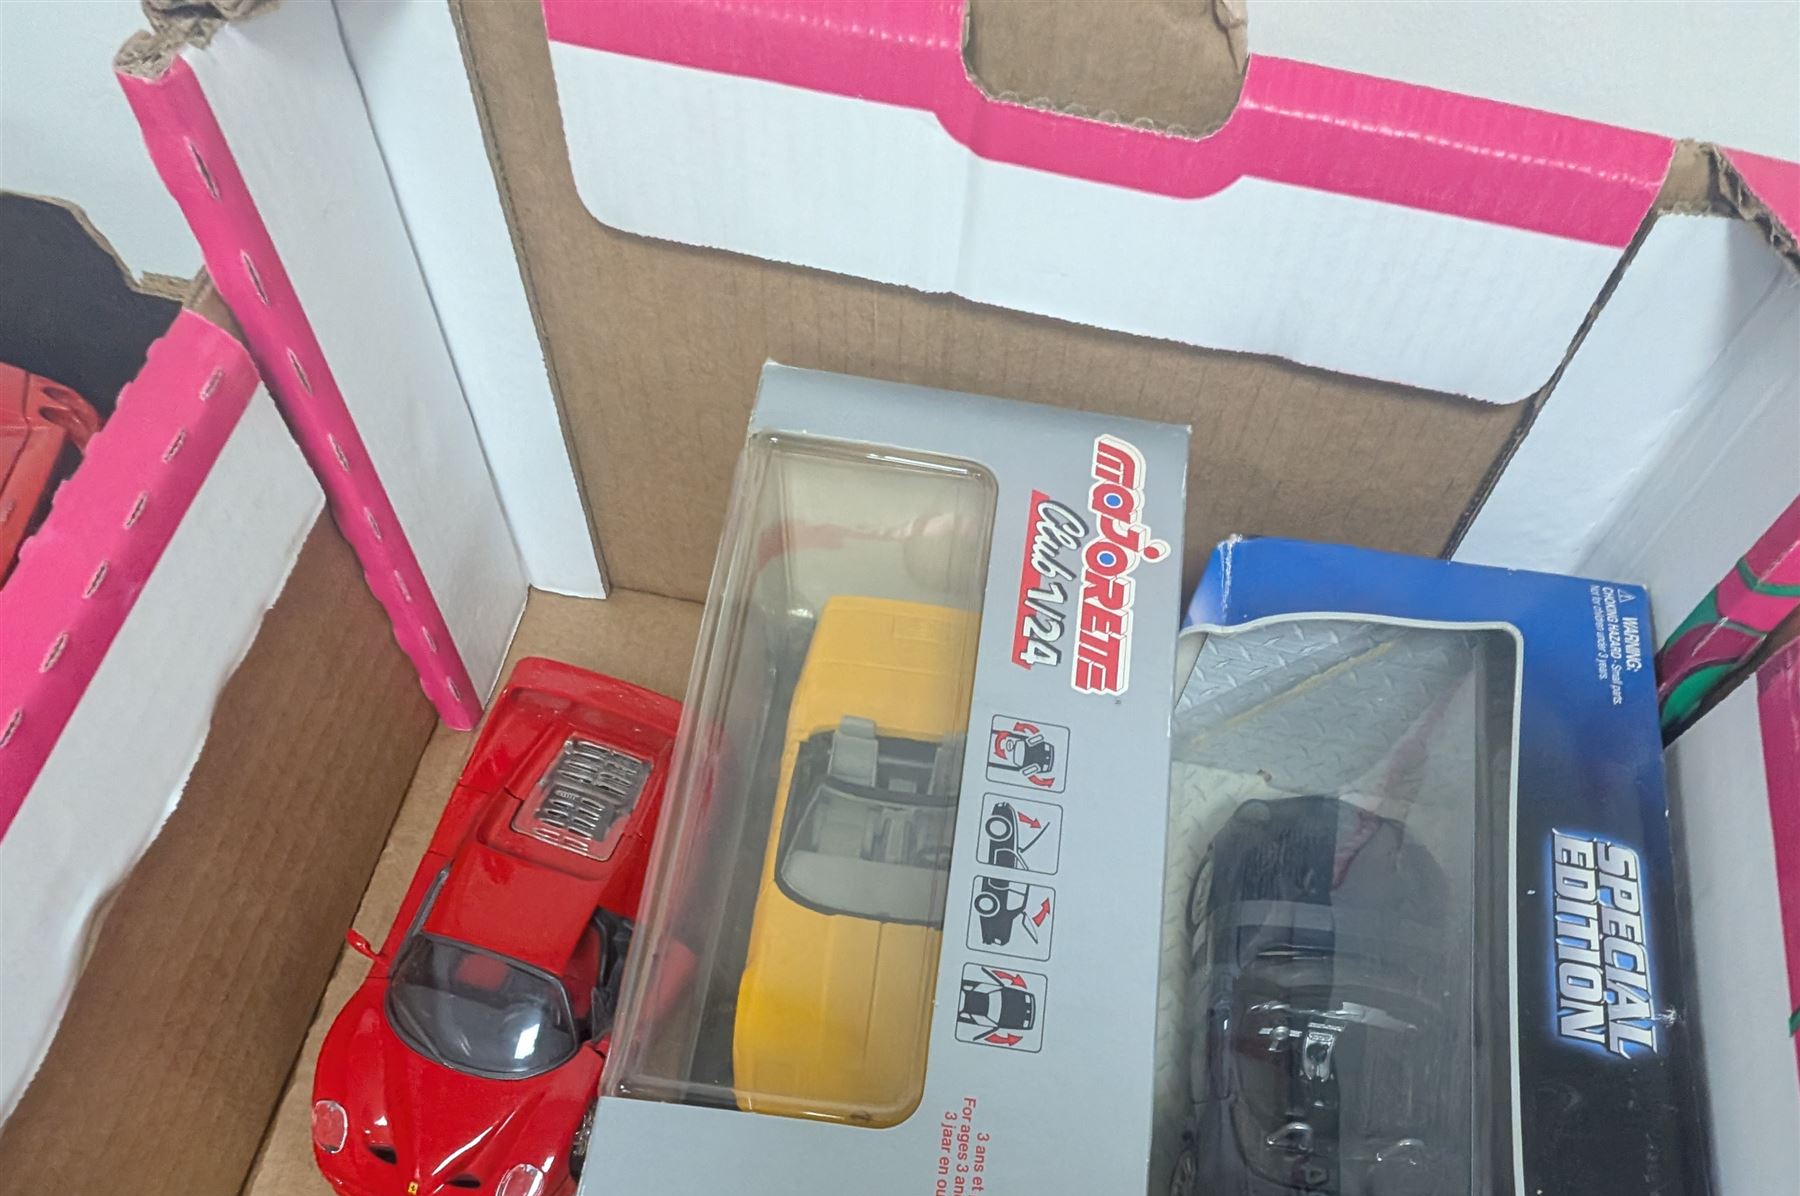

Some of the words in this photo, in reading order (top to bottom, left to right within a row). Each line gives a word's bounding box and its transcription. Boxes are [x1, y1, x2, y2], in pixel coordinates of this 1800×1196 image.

[1030, 497, 1090, 582] Club
[1602, 586, 1618, 623] CHOKING
[1020, 579, 1069, 668] 1/24
[1608, 623, 1622, 659] HAZARD
[1621, 616, 1642, 672] WARNING:
[1552, 827, 1605, 1044] EDITION
[1596, 840, 1657, 1059] SPECIAL
[945, 1111, 957, 1121] 3
[962, 1097, 977, 1122] For
[941, 1123, 957, 1153] jaar
[957, 1124, 970, 1161] ages
[977, 1132, 990, 1142] 3
[938, 1156, 950, 1175] en
[957, 1164, 969, 1173] 3
[974, 1145, 986, 1173] ans
[972, 1176, 984, 1191] et
